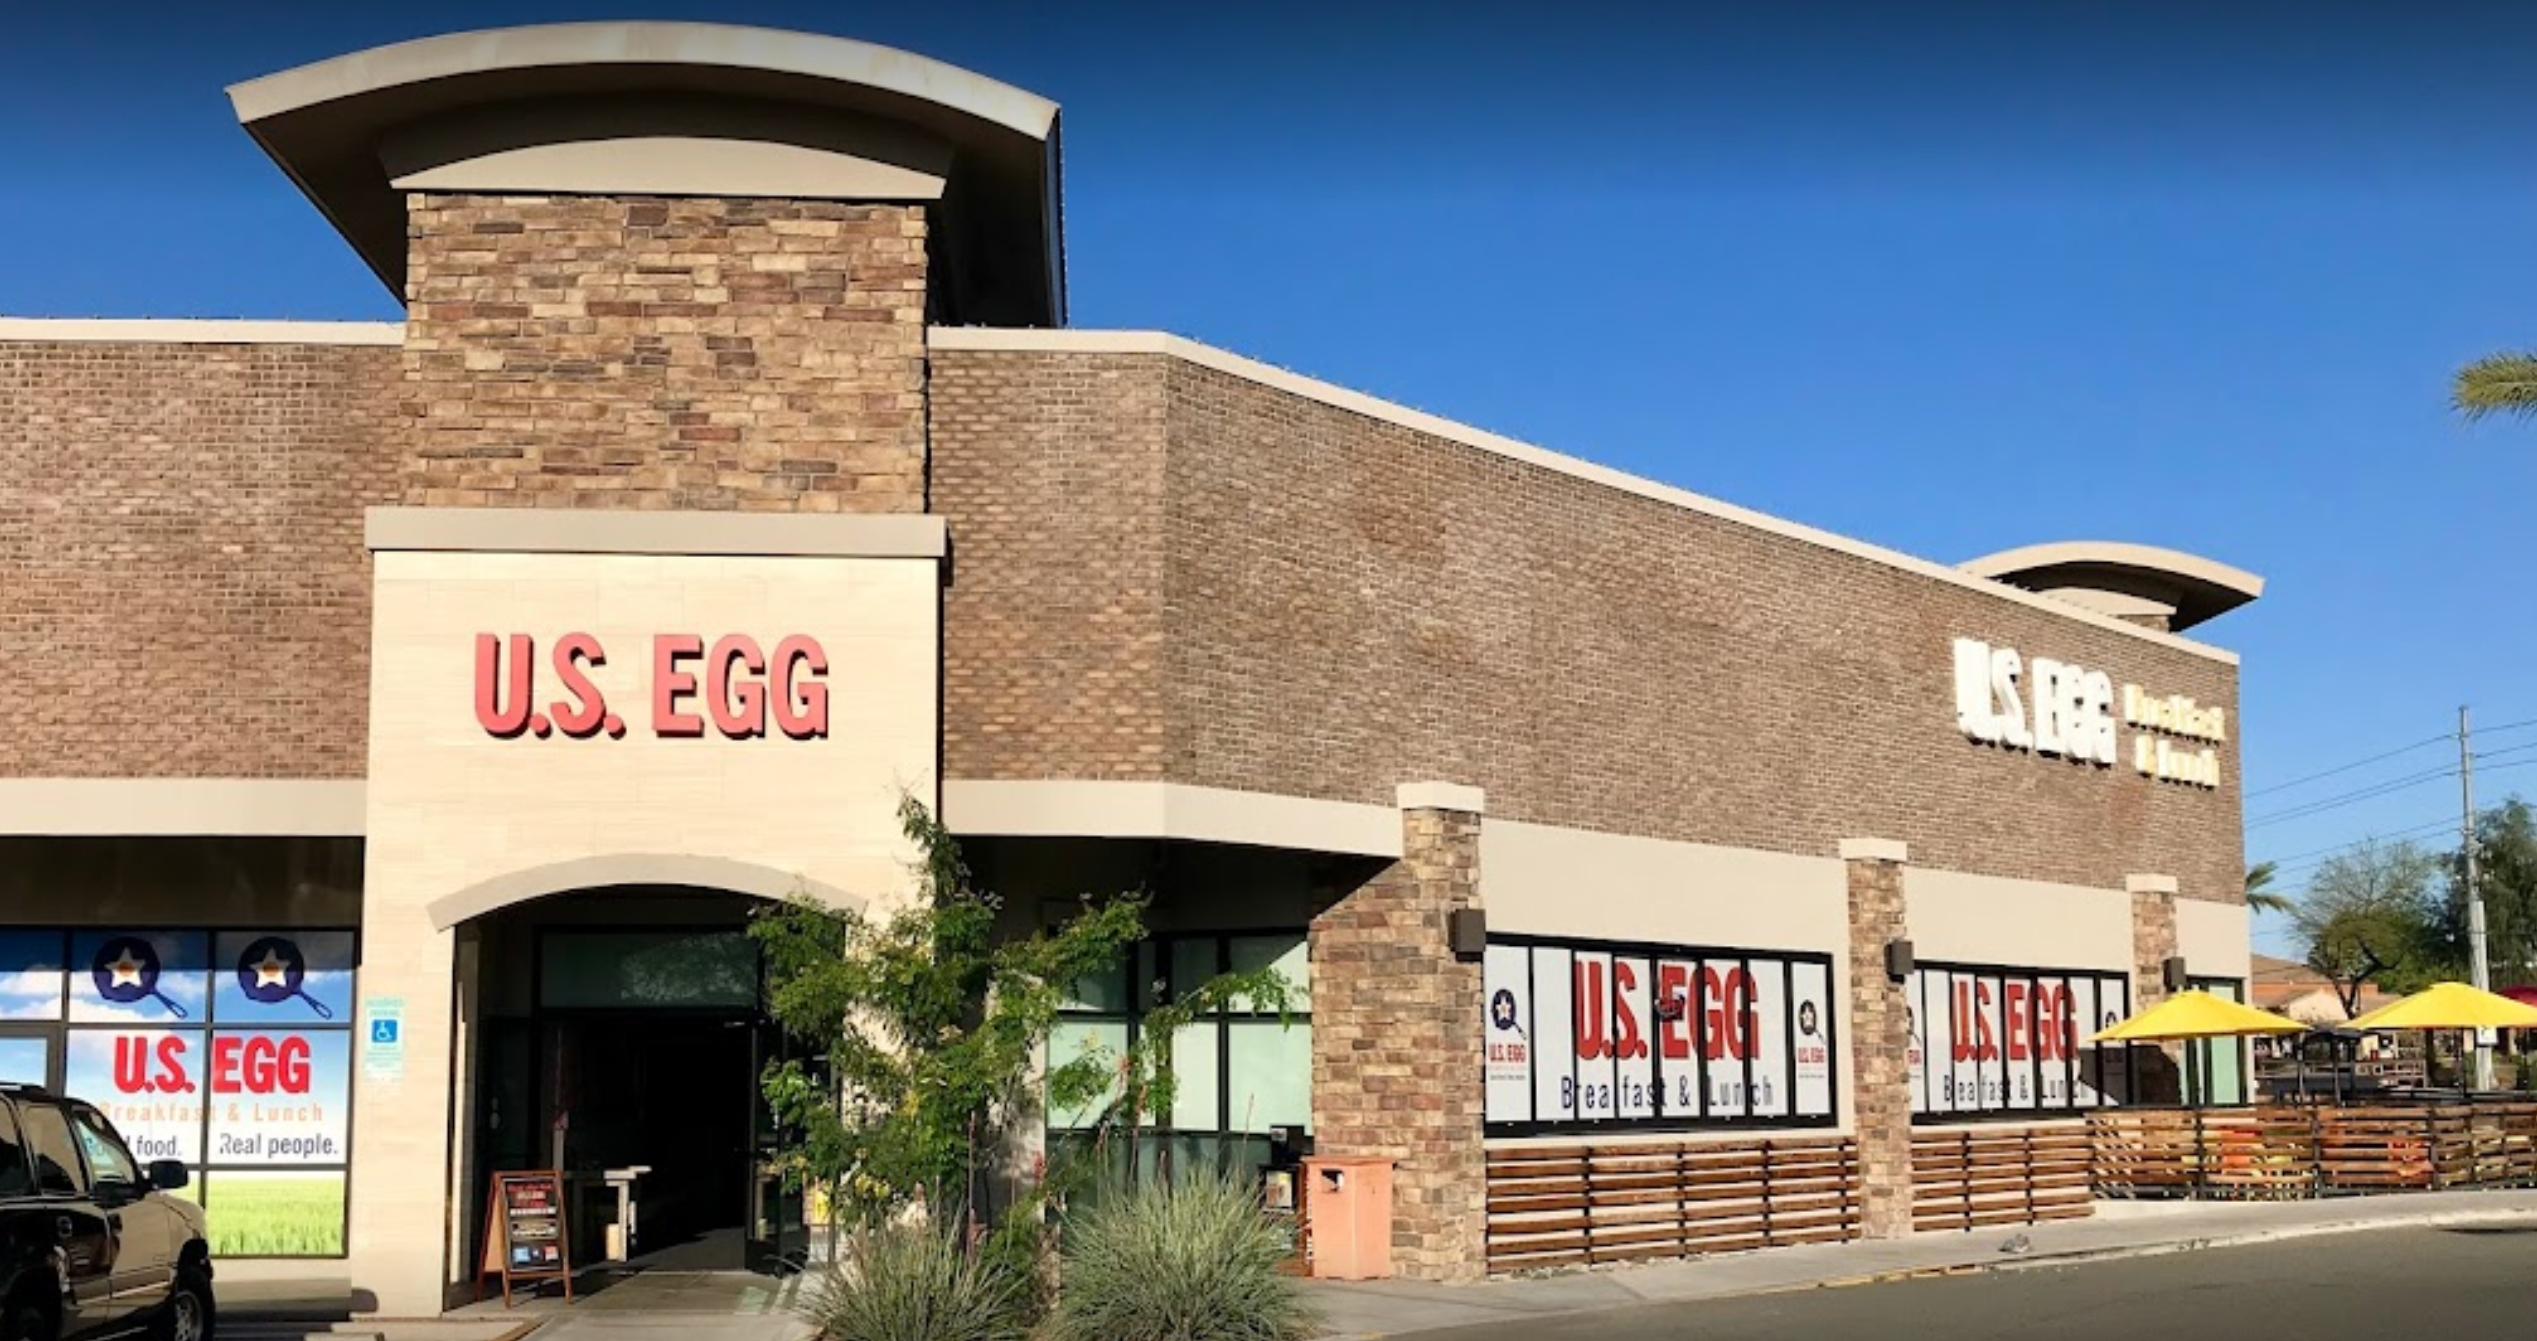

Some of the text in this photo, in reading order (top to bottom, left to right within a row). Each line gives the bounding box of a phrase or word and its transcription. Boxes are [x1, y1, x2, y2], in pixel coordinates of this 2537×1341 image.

[475, 632, 829, 741] U.S. EGG
[2032, 656, 2117, 769] EGG
[1573, 960, 1761, 1061] U.S. EGG
[2006, 982, 2080, 1063] EGG
[114, 1036, 312, 1095] U.S. EGG
[1679, 1074, 1691, 1107] &
[137, 1135, 182, 1157] food.
[219, 1133, 262, 1155] Real
[268, 1133, 339, 1159] people.
[228, 1103, 241, 1122] &
[254, 1103, 323, 1122] Lunch
